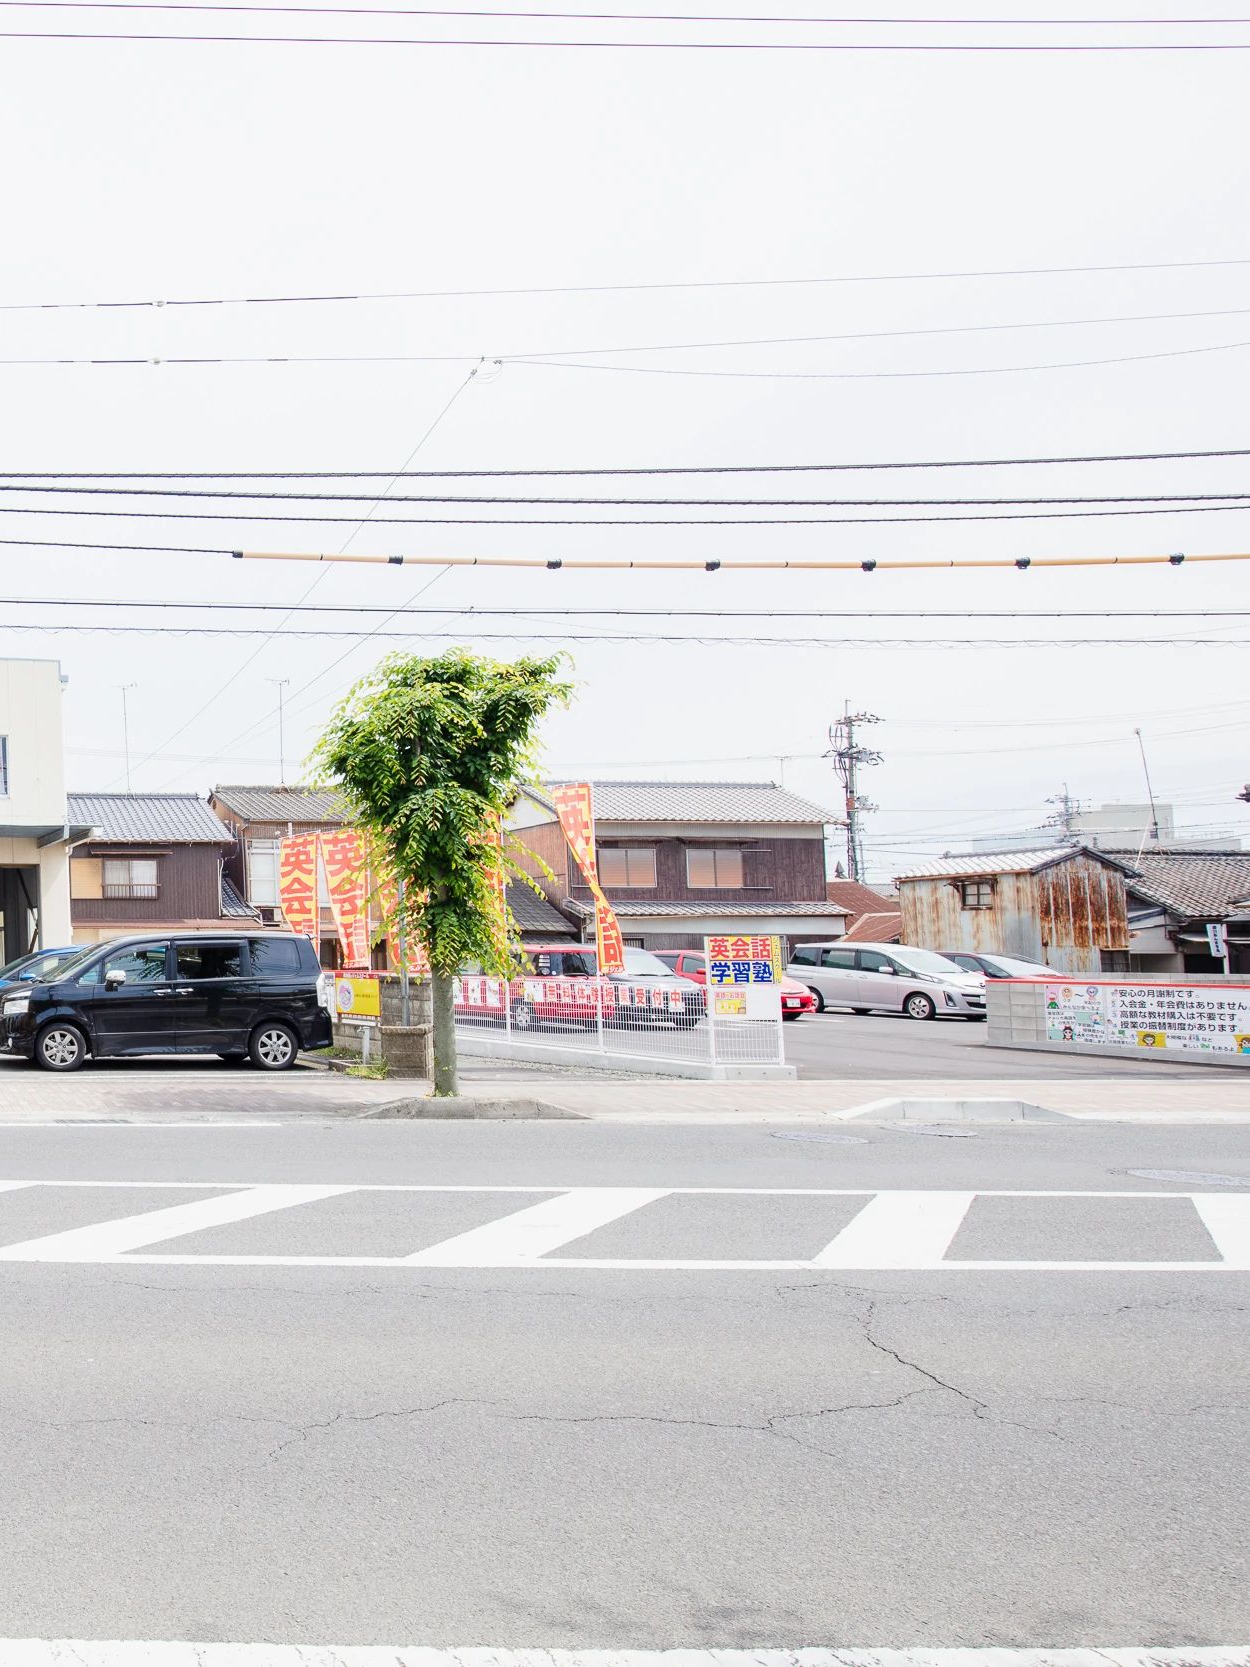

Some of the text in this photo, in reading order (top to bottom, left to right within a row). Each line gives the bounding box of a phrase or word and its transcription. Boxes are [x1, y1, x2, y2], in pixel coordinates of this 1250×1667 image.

[710, 937, 771, 959] 英会話
[711, 961, 773, 983] 学習塾
[547, 984, 682, 1008] 無料体験授業受付中
[1118, 989, 1200, 999] 安心の月謝制です。
[1120, 1010, 1243, 1022] 高額な教材購入は不要です。
[1120, 1021, 1244, 1033] 授業の振替制度があります。
